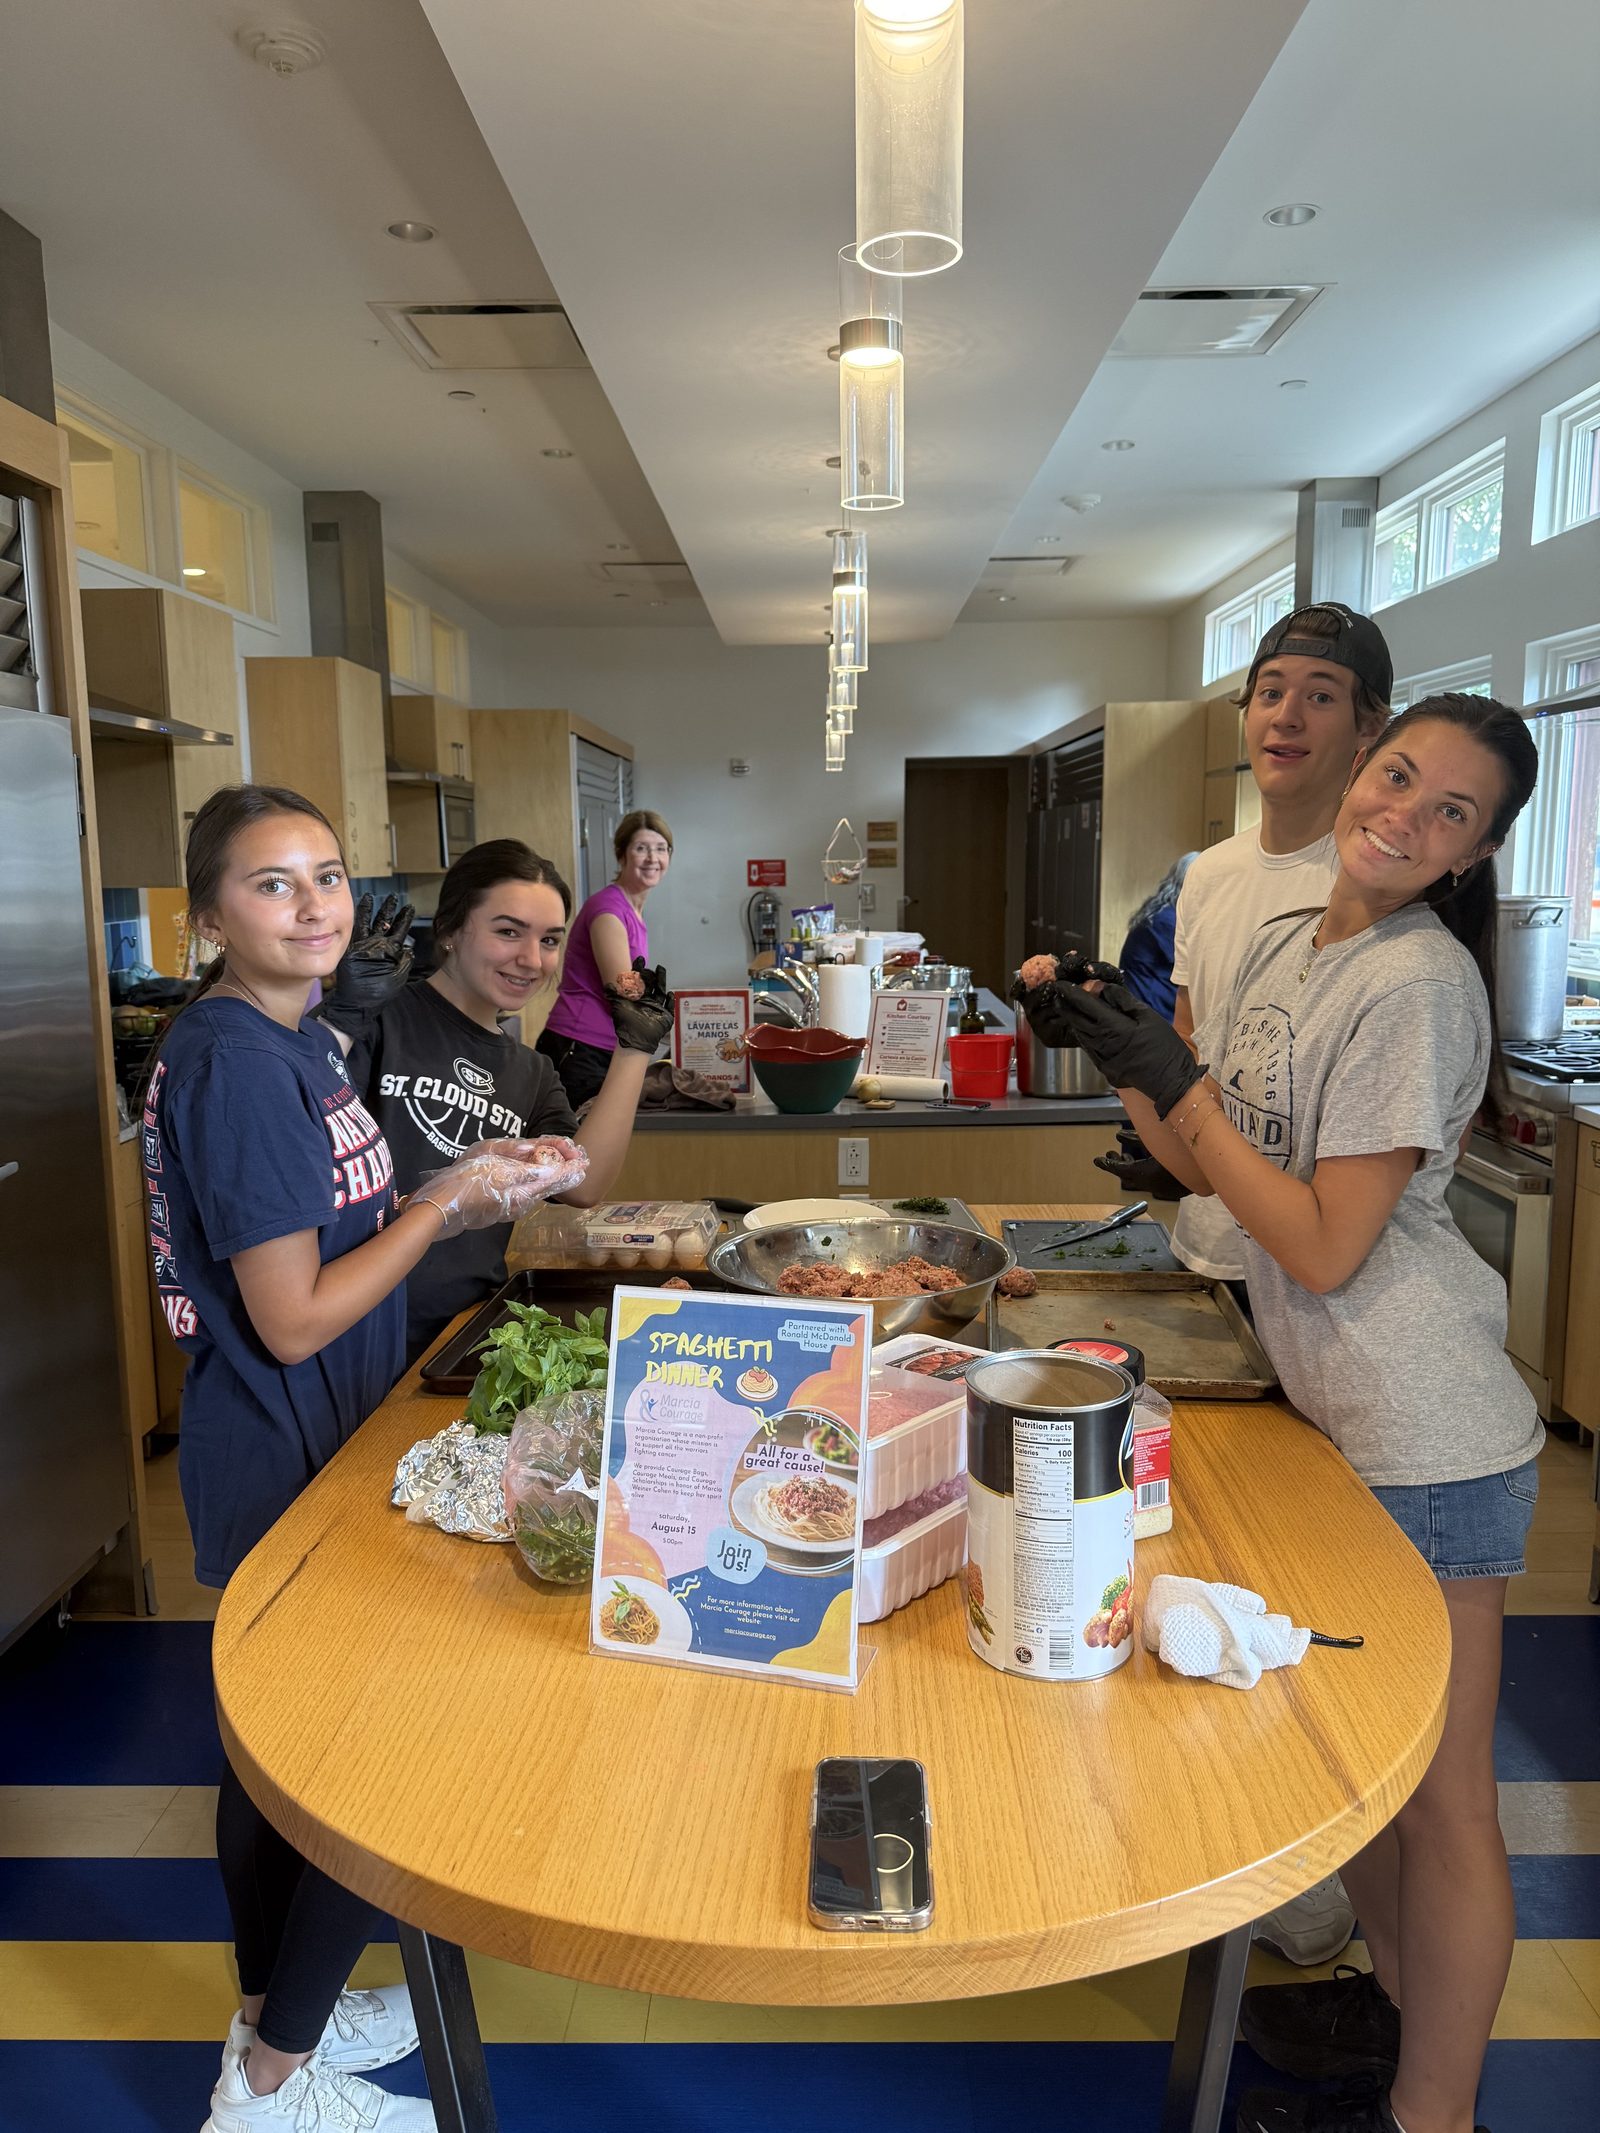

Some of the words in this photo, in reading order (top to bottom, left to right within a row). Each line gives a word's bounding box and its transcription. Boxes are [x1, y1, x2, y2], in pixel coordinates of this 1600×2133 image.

[687, 1021, 721, 1030] LÁVATE
[722, 1022, 739, 1030] LAS
[379, 1073, 411, 1097] ST.
[412, 1076, 489, 1119] CLOUD
[489, 1103, 528, 1139] STA
[788, 1321, 827, 1332] Partnered
[828, 1325, 845, 1334] with
[781, 1329, 809, 1339] Ronald
[811, 1332, 852, 1342] McDonald
[649, 1331, 774, 1363] SPAGHETTI
[803, 1340, 828, 1348] House
[645, 1360, 724, 1389] DINNER
[660, 1394, 701, 1409] Marcia
[659, 1406, 704, 1424] Courage
[635, 1426, 656, 1434] Marcia
[657, 1428, 682, 1437] Courage
[1014, 1419, 1048, 1430] Nutrition
[1050, 1423, 1072, 1431] Facts
[634, 1435, 671, 1443] organization
[634, 1447, 657, 1457] fighting
[758, 1445, 776, 1458] All
[780, 1447, 799, 1460] for
[802, 1453, 811, 1461] a
[1014, 1446, 1039, 1456] Calories
[1057, 1449, 1072, 1457] 100
[666, 1465, 691, 1475] Courage
[745, 1456, 780, 1468] great
[784, 1460, 825, 1473] cause!
[632, 1469, 657, 1478] Courage
[691, 1476, 717, 1485] Courage
[632, 1477, 667, 1486] Scholarships
[702, 1484, 723, 1492] Marcia
[631, 1484, 651, 1492] Weiner
[652, 1486, 672, 1494] Cohen
[659, 1512, 690, 1523] saturday,
[651, 1520, 685, 1534] August
[687, 1526, 697, 1535] 15
[717, 1539, 752, 1559] Join
[722, 1553, 750, 1573] Us!
[700, 1602, 722, 1612] Marcia
[724, 1605, 750, 1616] Courage
[752, 1609, 773, 1619] please
[707, 1595, 717, 1603] For
[736, 1600, 773, 1612] information
[774, 1604, 794, 1614] about
